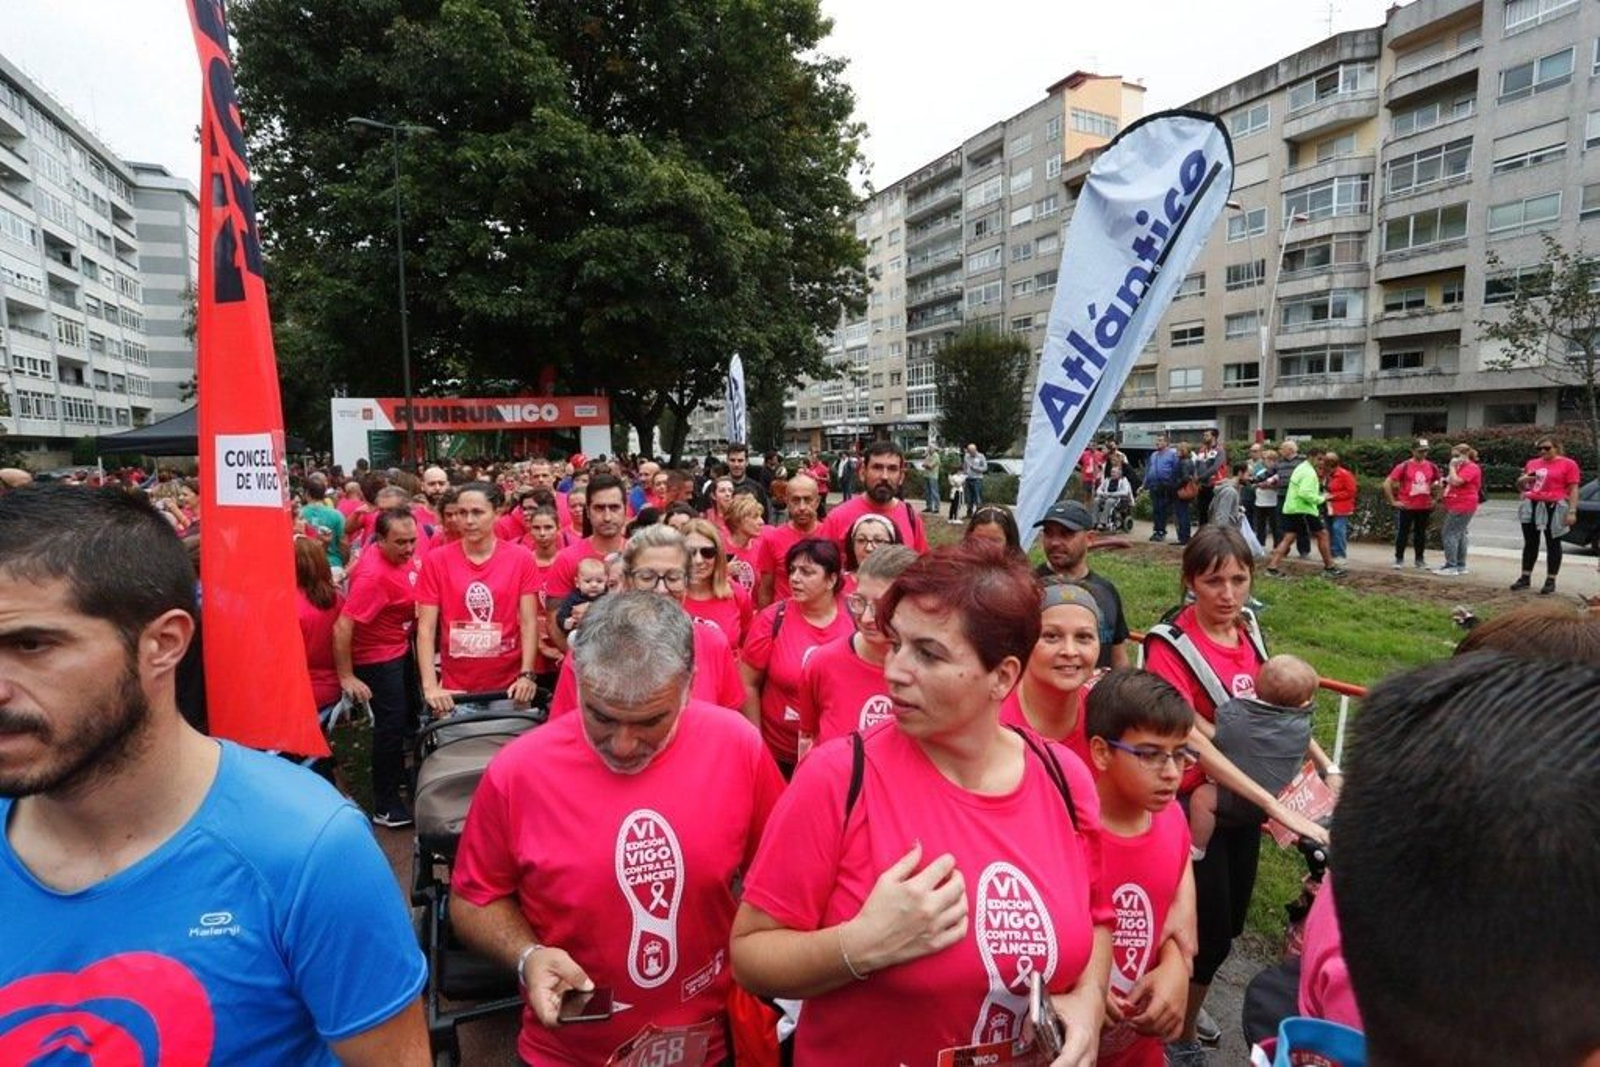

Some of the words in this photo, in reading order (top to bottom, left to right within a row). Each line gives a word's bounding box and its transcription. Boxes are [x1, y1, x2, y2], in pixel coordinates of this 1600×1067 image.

[1038, 149, 1207, 437] Atlántico
[224, 449, 276, 467] CONCELL
[236, 472, 252, 490] DE
[632, 821, 655, 839] VI
[626, 846, 671, 866] VIGO
[625, 862, 662, 875] CONTRA
[663, 860, 675, 869] EL
[992, 876, 1020, 898] VI
[1121, 894, 1138, 909] VI
[986, 910, 1040, 930] VIGO
[188, 924, 241, 938] Kalenji
[986, 930, 1031, 940] CONTRA
[1032, 931, 1048, 941] EL
